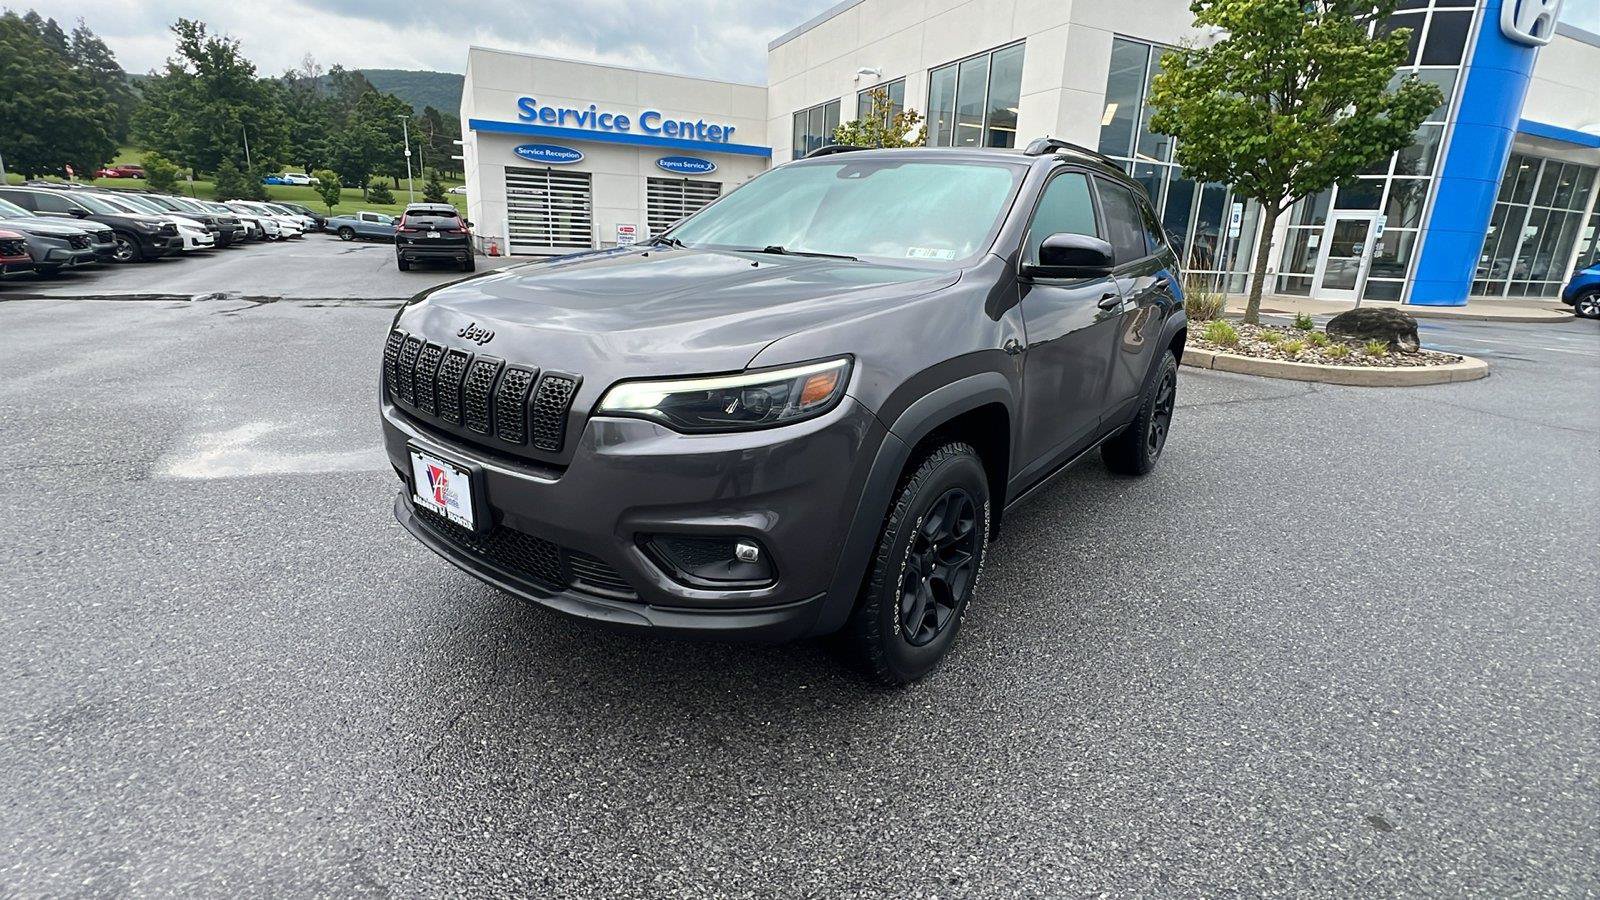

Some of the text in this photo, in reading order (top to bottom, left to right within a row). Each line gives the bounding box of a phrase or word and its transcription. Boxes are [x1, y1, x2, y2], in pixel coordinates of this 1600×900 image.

[517, 96, 736, 143] Service Center
[518, 147, 580, 159] Service Reception
[659, 159, 705, 169] Express Service
[457, 322, 495, 346] Jeep
